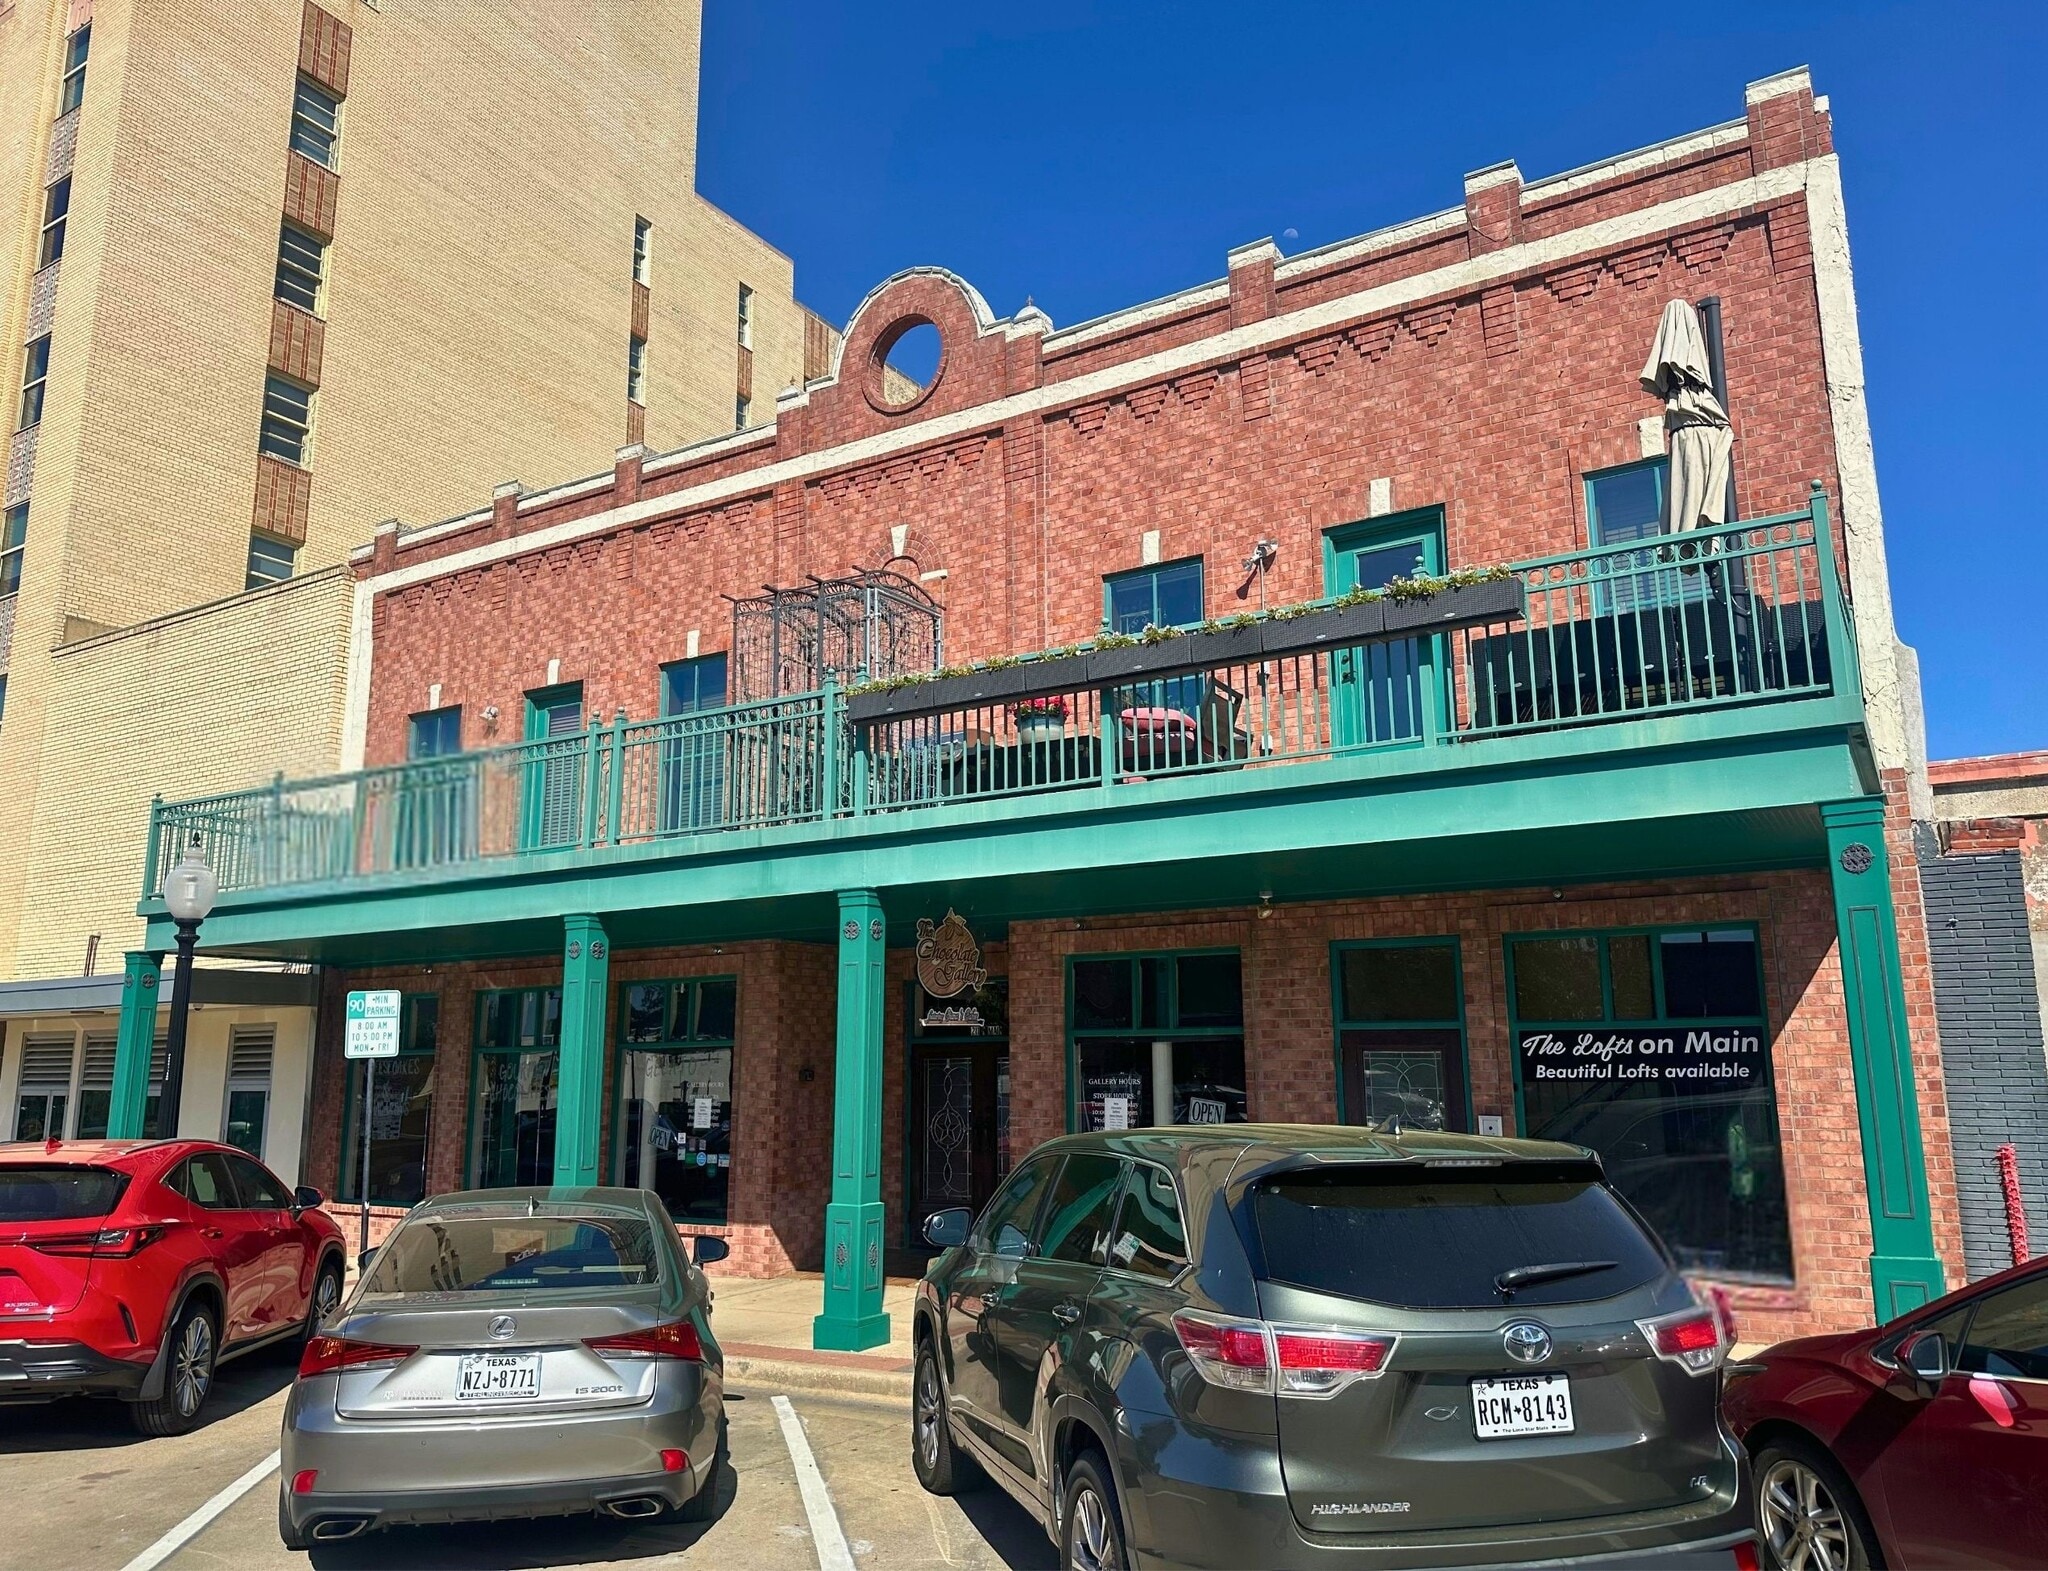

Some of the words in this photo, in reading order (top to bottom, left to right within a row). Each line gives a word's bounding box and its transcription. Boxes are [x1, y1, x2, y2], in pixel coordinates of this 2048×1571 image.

[919, 920, 935, 938] The
[919, 938, 978, 961] Chocolate
[934, 961, 986, 989] Gallery
[350, 1000, 364, 1012] 90
[367, 1006, 395, 1015] PARKING
[358, 1022, 374, 1030] 800
[352, 1033, 360, 1041] TO
[364, 1032, 379, 1040] 500
[383, 1032, 392, 1040] PM
[354, 1044, 368, 1052] MON
[378, 1043, 389, 1051] FRI
[1522, 1034, 1566, 1056] The
[1572, 1033, 1634, 1061] Lofts
[1638, 1038, 1674, 1054] on
[1684, 1030, 1759, 1054] Main
[1536, 1064, 1612, 1078] Beautiful
[1618, 1063, 1659, 1078] Lofts
[1665, 1062, 1750, 1078] available
[1192, 1101, 1222, 1124] OPEN
[650, 1128, 670, 1149] OPEN
[487, 1358, 517, 1367] TEXAS
[463, 1371, 491, 1390] NZJ
[499, 1369, 535, 1388] 8771
[1501, 1378, 1539, 1391] TEXAS
[591, 1385, 623, 1393] 200t
[1478, 1398, 1513, 1425] RCM
[1521, 1394, 1567, 1422] 8143
[1310, 1502, 1411, 1515] HIGHLANDER
